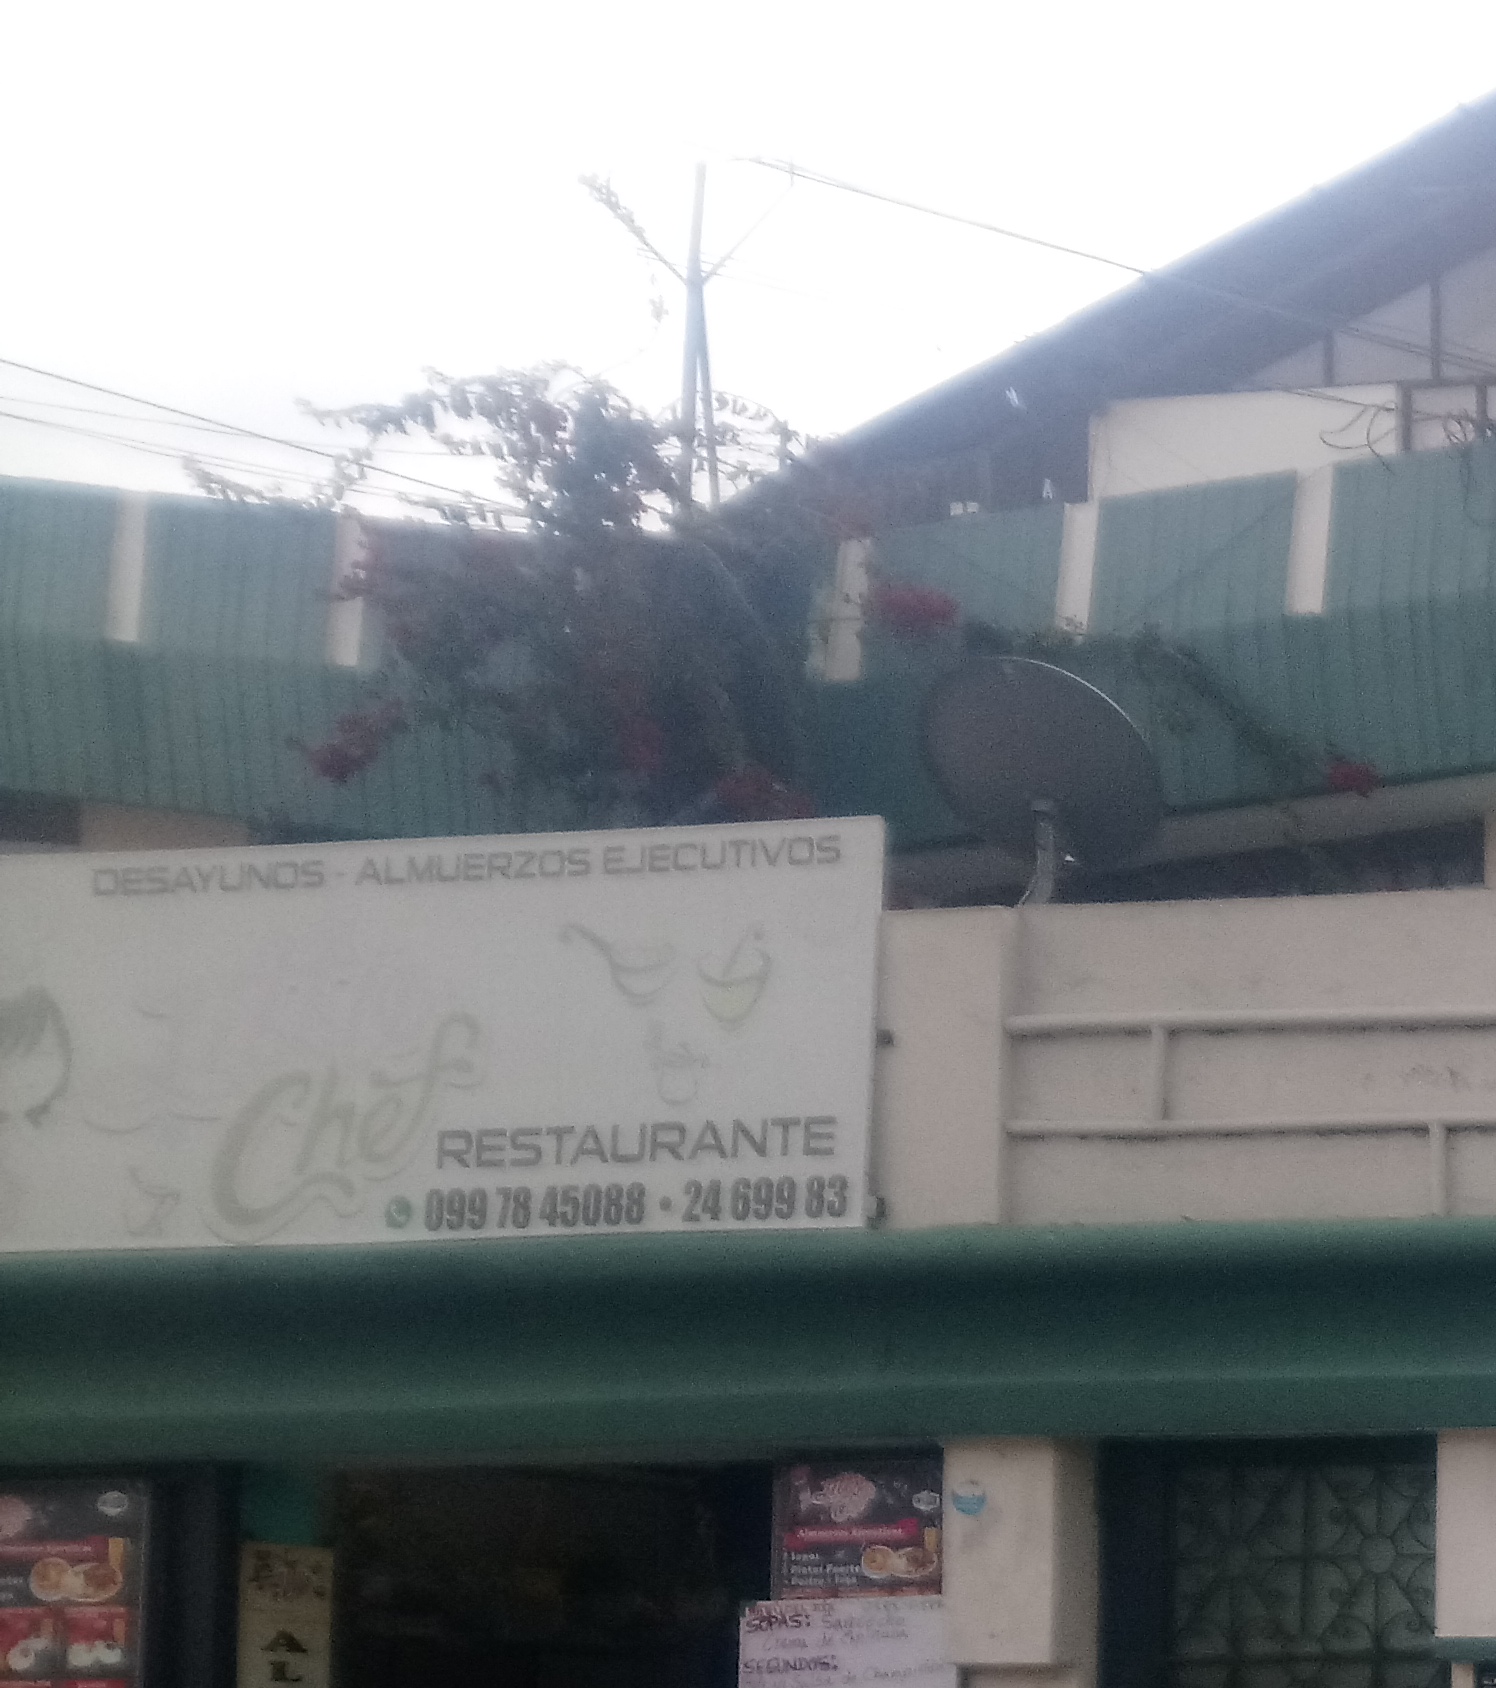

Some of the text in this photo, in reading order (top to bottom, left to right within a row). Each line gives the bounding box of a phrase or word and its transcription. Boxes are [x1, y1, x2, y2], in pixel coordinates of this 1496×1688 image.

[92, 859, 326, 897] DESAYUNOS
[355, 846, 592, 887] ALMUERZOS
[603, 835, 842, 876] EJECUTIVOS
[211, 1013, 480, 1228] Chef
[435, 1115, 839, 1169] RESTAURANTE
[423, 1187, 488, 1232] 099
[495, 1185, 532, 1230] 78
[681, 1177, 723, 1223] 24
[730, 1174, 797, 1221] 699
[804, 1173, 850, 1219] 83
